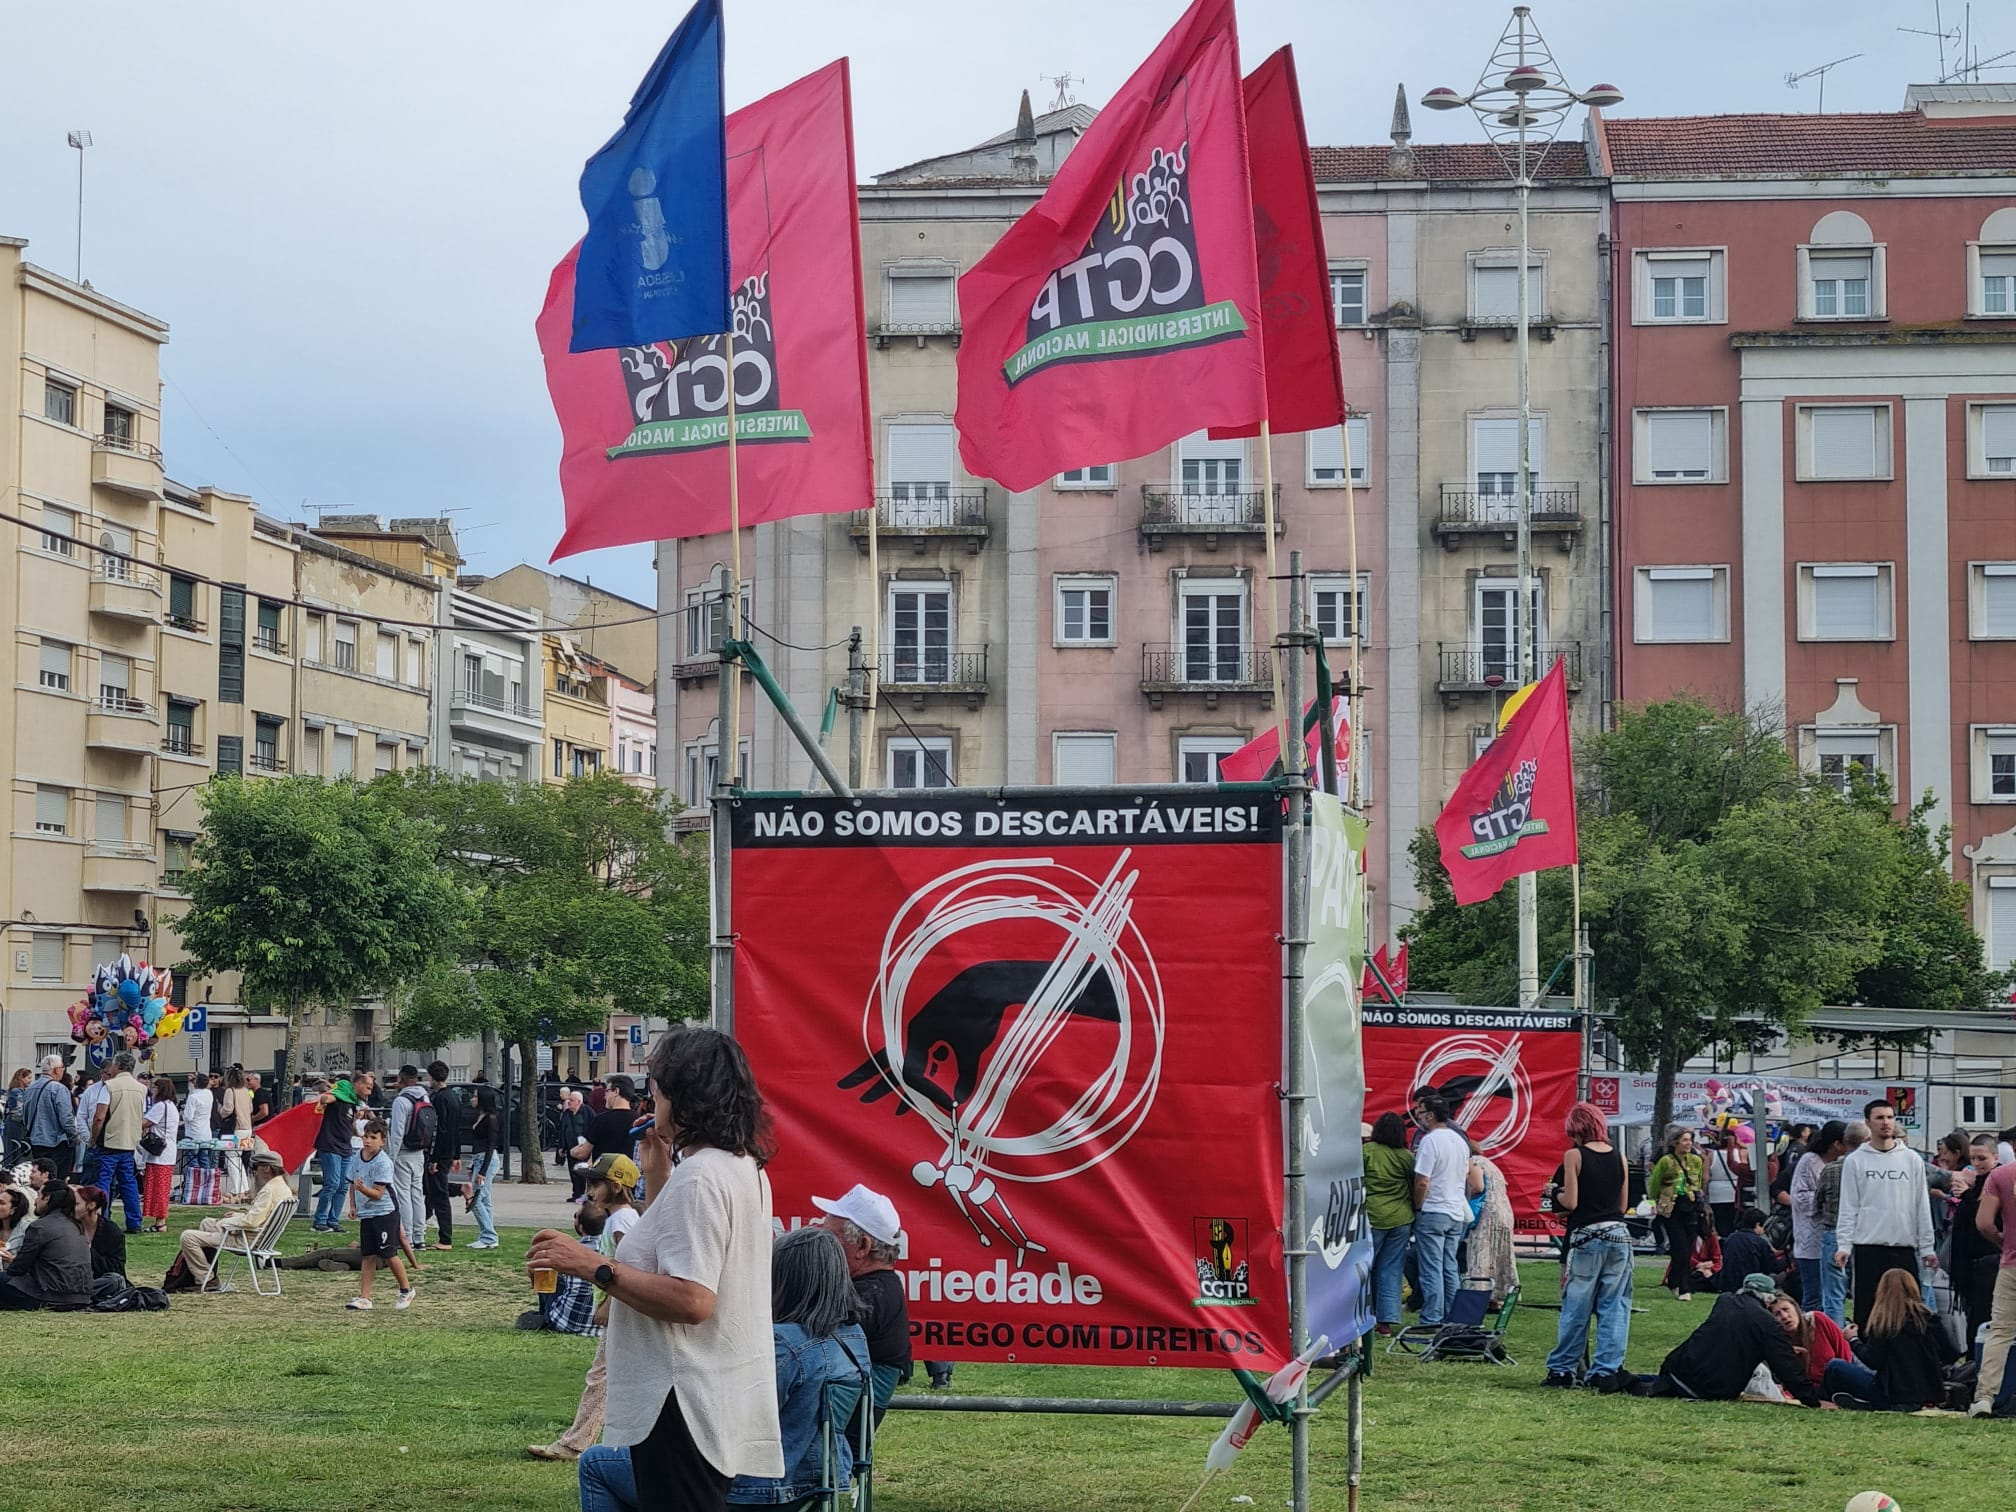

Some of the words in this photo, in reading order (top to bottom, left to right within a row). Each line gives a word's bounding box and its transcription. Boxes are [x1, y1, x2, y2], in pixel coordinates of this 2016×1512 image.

[754, 805, 824, 837] NÃO
[834, 808, 963, 837] SOMOS
[975, 801, 1259, 837] DESCARTÁVEIS!
[1362, 1009, 1394, 1024] NÃO
[1398, 1013, 1451, 1026] SOMOS
[1455, 1014, 1572, 1029] DESCARTÁVEIS!
[1674, 1091, 1699, 1101] ergia
[1865, 1170, 1909, 1180] RVCA
[1514, 1218, 1567, 1230] IREITOS
[381, 1231, 388, 1244] 9
[897, 1258, 1103, 1306] riedade
[1201, 1280, 1248, 1298] CGTP
[1022, 1321, 1100, 1349] COM
[1111, 1324, 1265, 1356] DIREITOS
